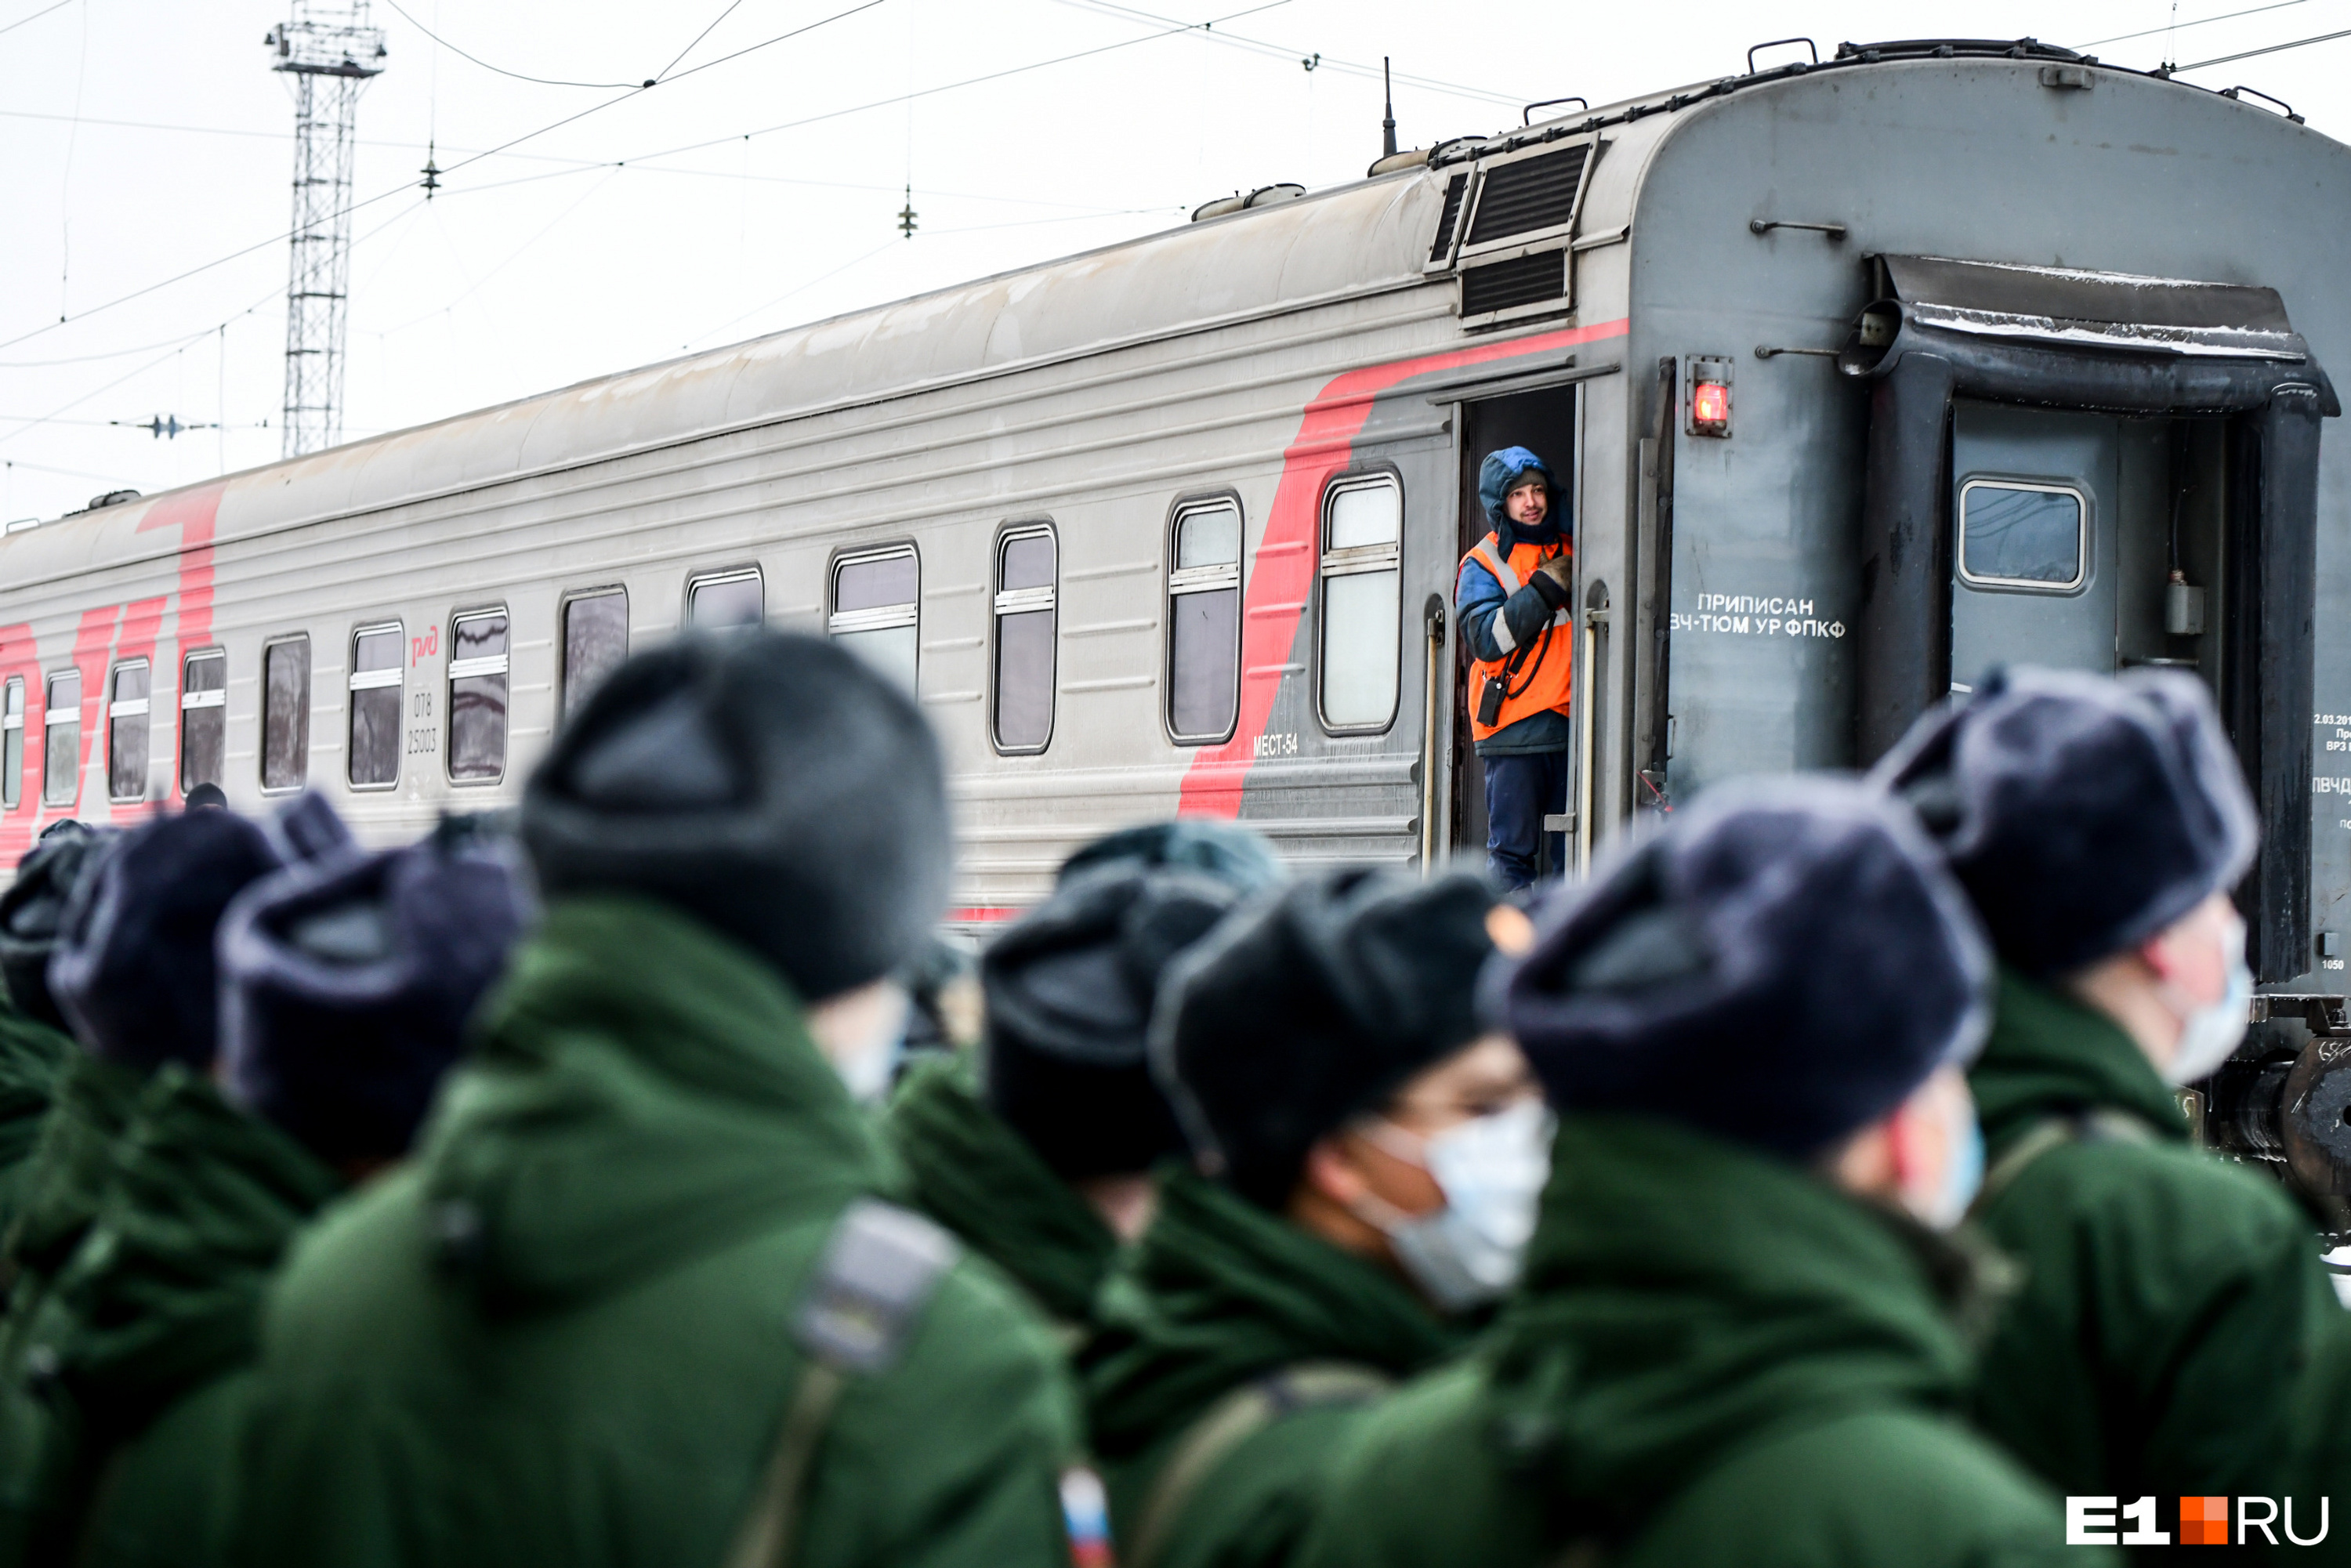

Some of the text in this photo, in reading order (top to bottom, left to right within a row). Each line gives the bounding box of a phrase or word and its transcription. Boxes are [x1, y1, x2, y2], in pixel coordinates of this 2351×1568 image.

[1697, 593, 1813, 615] ПРИПИСАН
[414, 693, 432, 718] 078
[408, 728, 437, 755] 25003
[1253, 733, 1298, 757] МЕСТ-54
[2322, 960, 2344, 970] 1050
